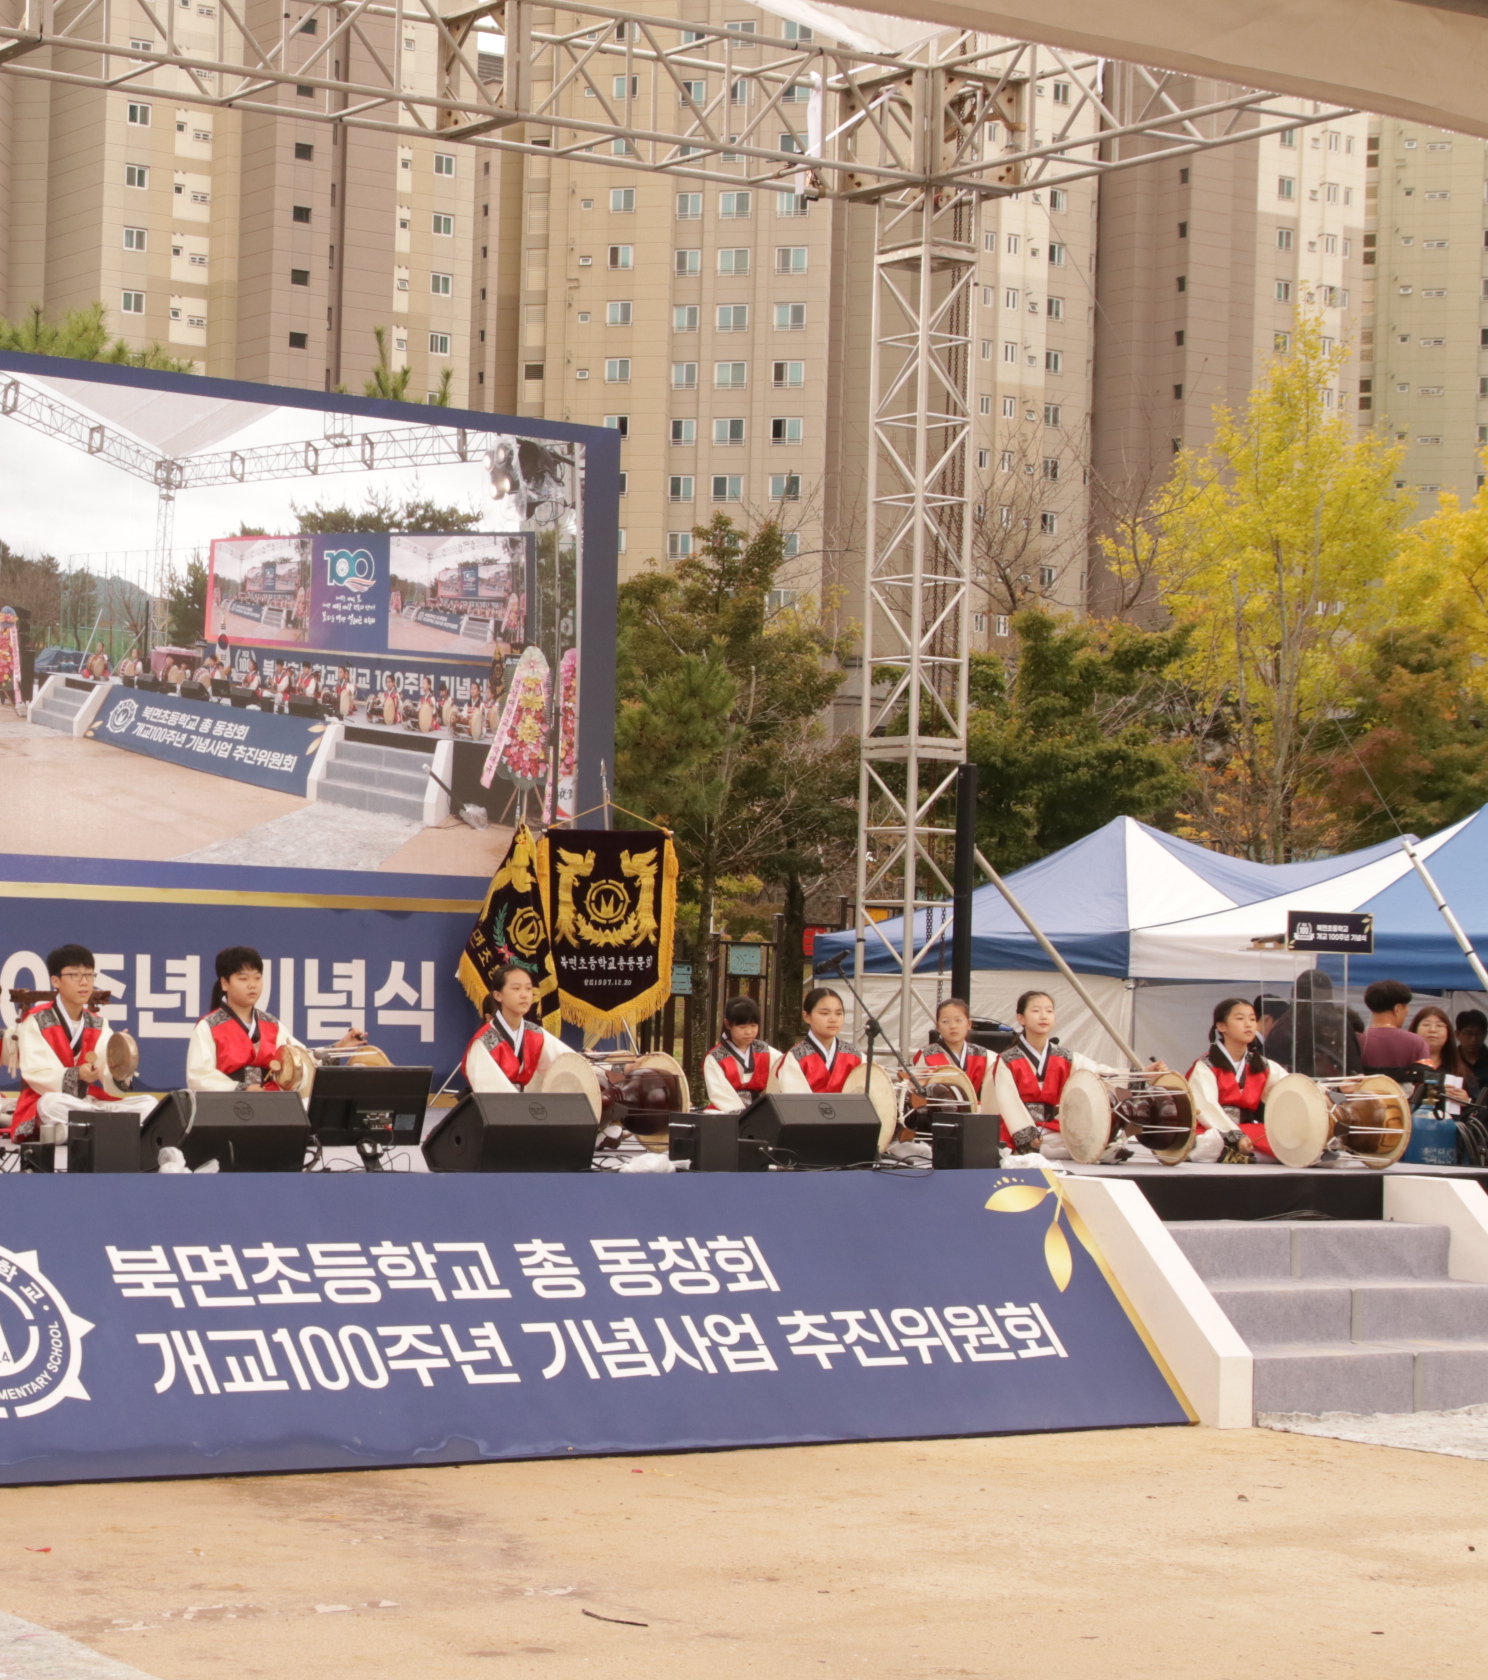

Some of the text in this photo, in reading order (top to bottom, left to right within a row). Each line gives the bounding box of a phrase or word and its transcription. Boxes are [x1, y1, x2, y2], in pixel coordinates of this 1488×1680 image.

[324, 548, 375, 587] 100
[142, 705, 200, 730] 북면초등학교
[212, 721, 250, 741] 동창회
[187, 735, 232, 758] 기념사업
[232, 744, 298, 772] 추진위원회
[105, 1235, 781, 1308] 북면초등학교 총 동창회
[46, 1321, 63, 1374] SCHOOL
[136, 1301, 1068, 1395] 개교100주년 기념사업 추진위원회
